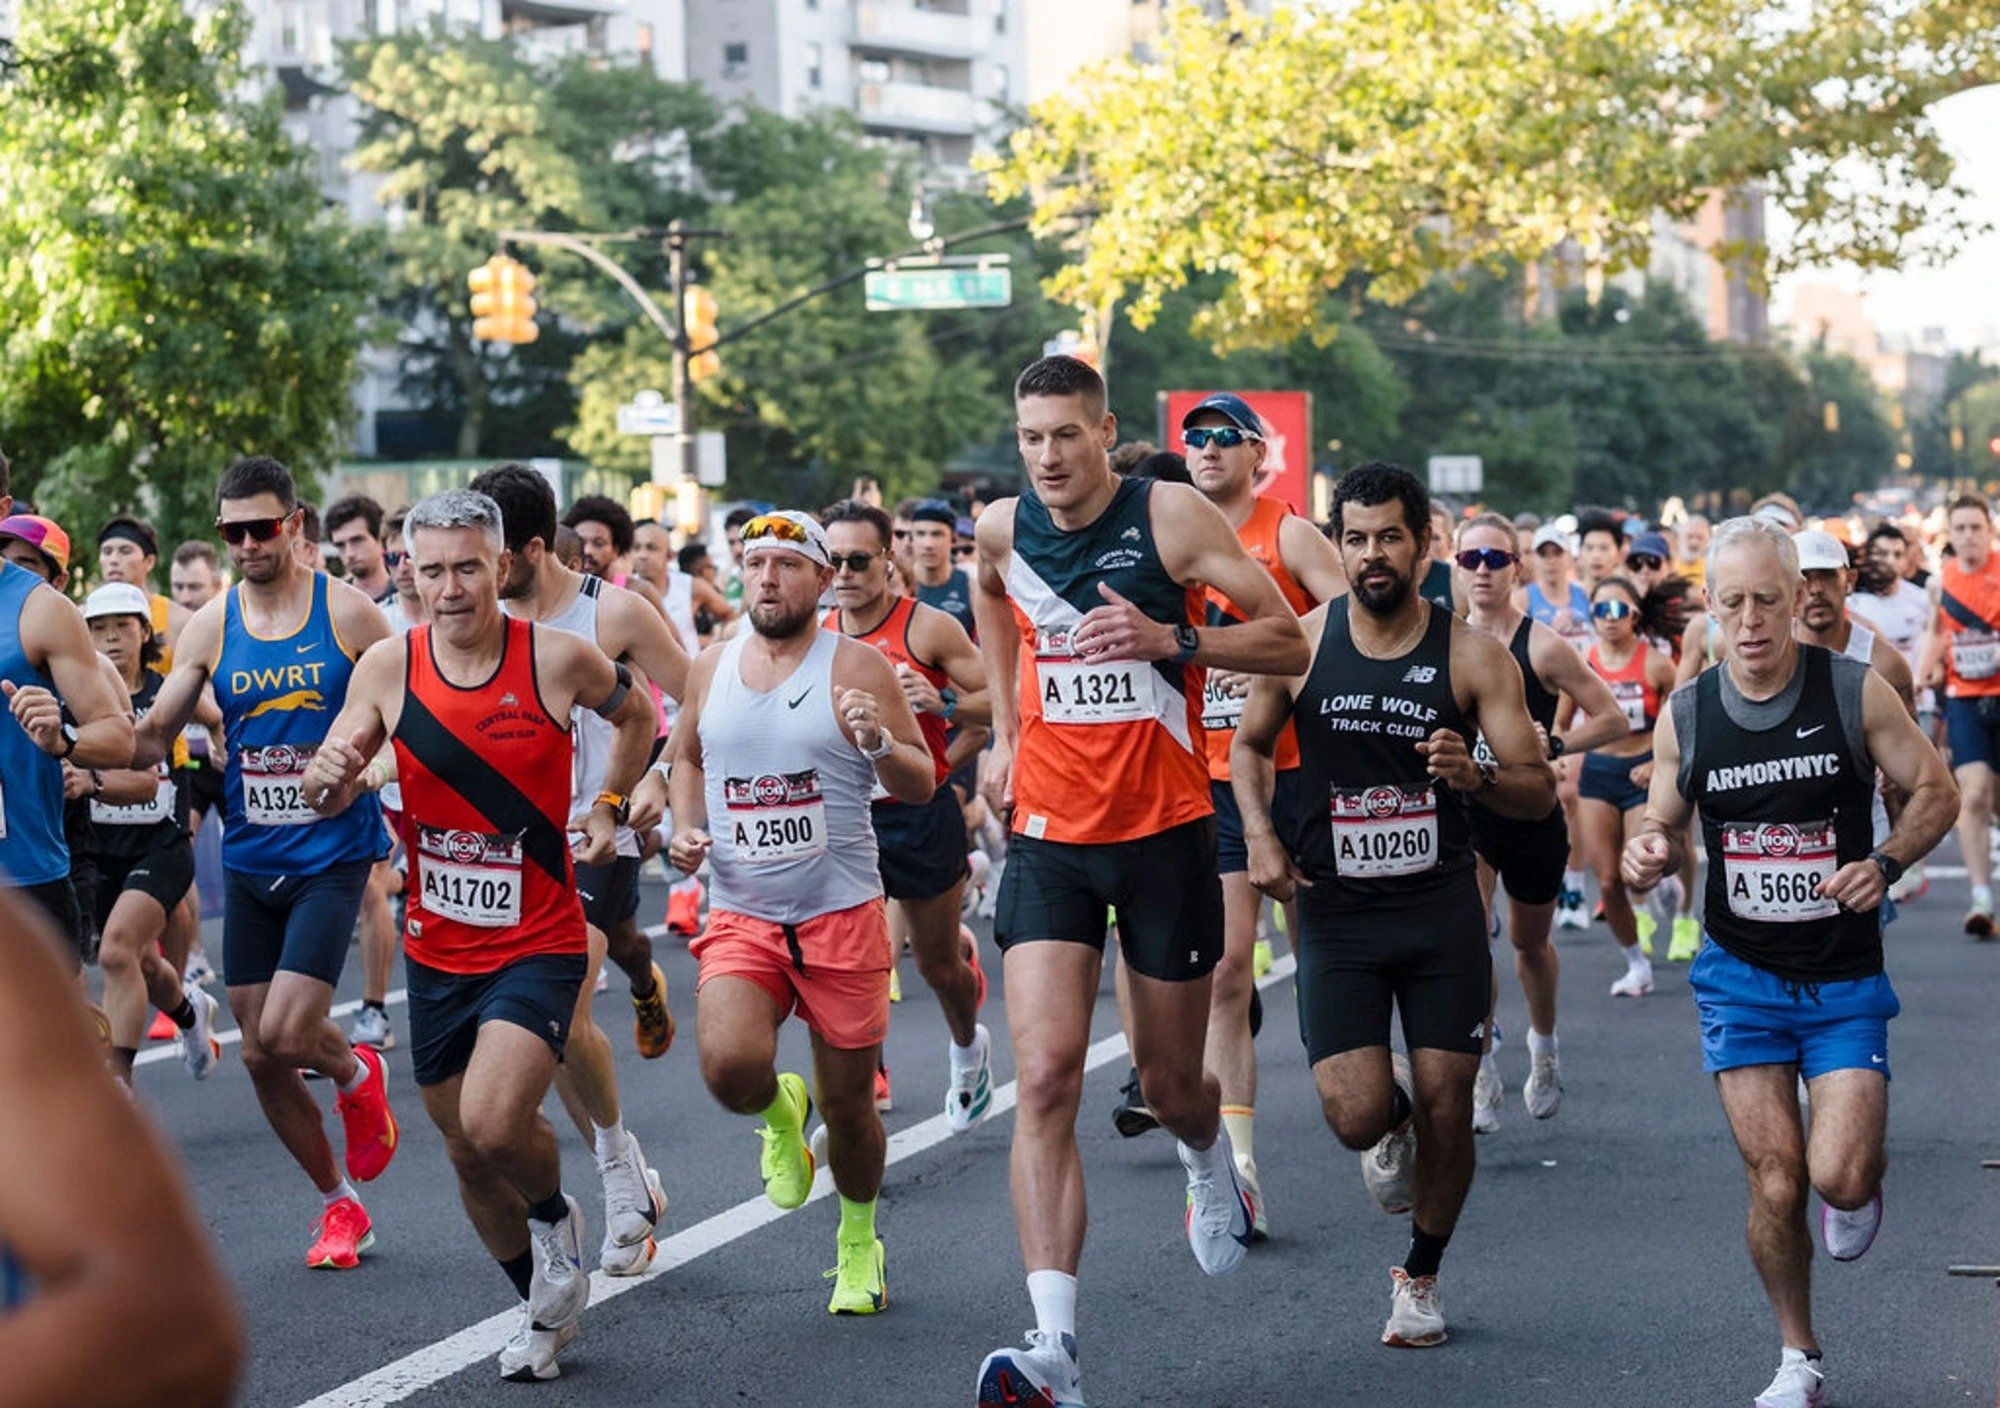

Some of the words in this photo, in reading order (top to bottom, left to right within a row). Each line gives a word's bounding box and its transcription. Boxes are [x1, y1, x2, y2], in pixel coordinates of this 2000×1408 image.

[231, 662, 325, 694] DWRT
[1046, 676, 1062, 704] A
[1072, 671, 1136, 705] 1321
[1320, 694, 1374, 714] LONE
[1381, 696, 1438, 722] WOLF
[1331, 718, 1382, 733] TRACK
[1386, 723, 1426, 738] CLUB
[1706, 753, 1840, 792] ARMORYNYC
[735, 821, 750, 846] A
[756, 815, 813, 847] 2500
[1733, 872, 1751, 899] A
[1761, 871, 1823, 903] 5668
